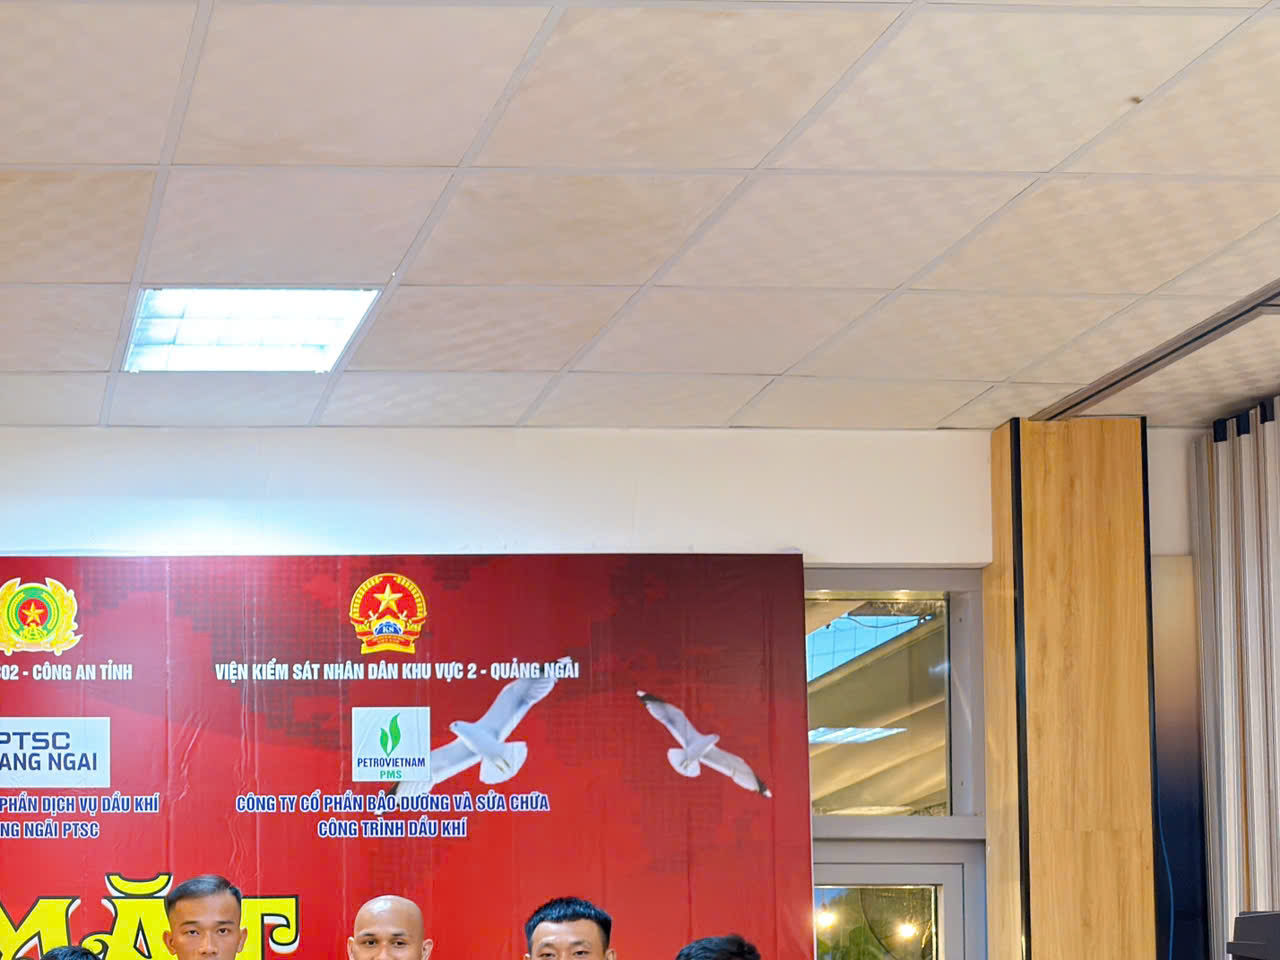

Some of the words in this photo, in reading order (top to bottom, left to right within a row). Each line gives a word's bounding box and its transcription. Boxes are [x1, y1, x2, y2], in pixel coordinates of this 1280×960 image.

[33, 661, 72, 680] CÔNG
[76, 664, 97, 680] AN
[100, 660, 133, 680] TỈNH
[215, 661, 248, 683] VIỆN
[252, 658, 289, 680] KIỂM
[292, 660, 320, 680] SÁT
[324, 660, 365, 680] NHÂN
[368, 660, 398, 680] DÂN
[402, 663, 431, 679] KHU
[435, 661, 464, 683] VỰC
[467, 663, 477, 679] 2
[490, 658, 540, 680] QUẢNG
[48, 753, 97, 771] NGAI
[357, 757, 425, 768] PETROVIETNAM
[379, 770, 402, 779] PMS
[41, 796, 76, 816] DỊCH
[79, 796, 98, 816] VỤ
[134, 792, 160, 813] KHÍ
[236, 792, 276, 812] CÔNG
[279, 795, 297, 812] TY
[300, 789, 321, 812] CỔ
[367, 790, 397, 812] BẢO
[399, 791, 450, 811] DƯỠNG
[453, 790, 474, 811] VÀ
[476, 790, 507, 811] SỬA
[509, 790, 550, 811] CHỮA
[23, 818, 59, 838] NGÃI
[62, 821, 100, 838] PTSC
[318, 817, 358, 838] CÔNG
[361, 817, 405, 838] TRÌNH
[441, 816, 468, 837] KHÍ
